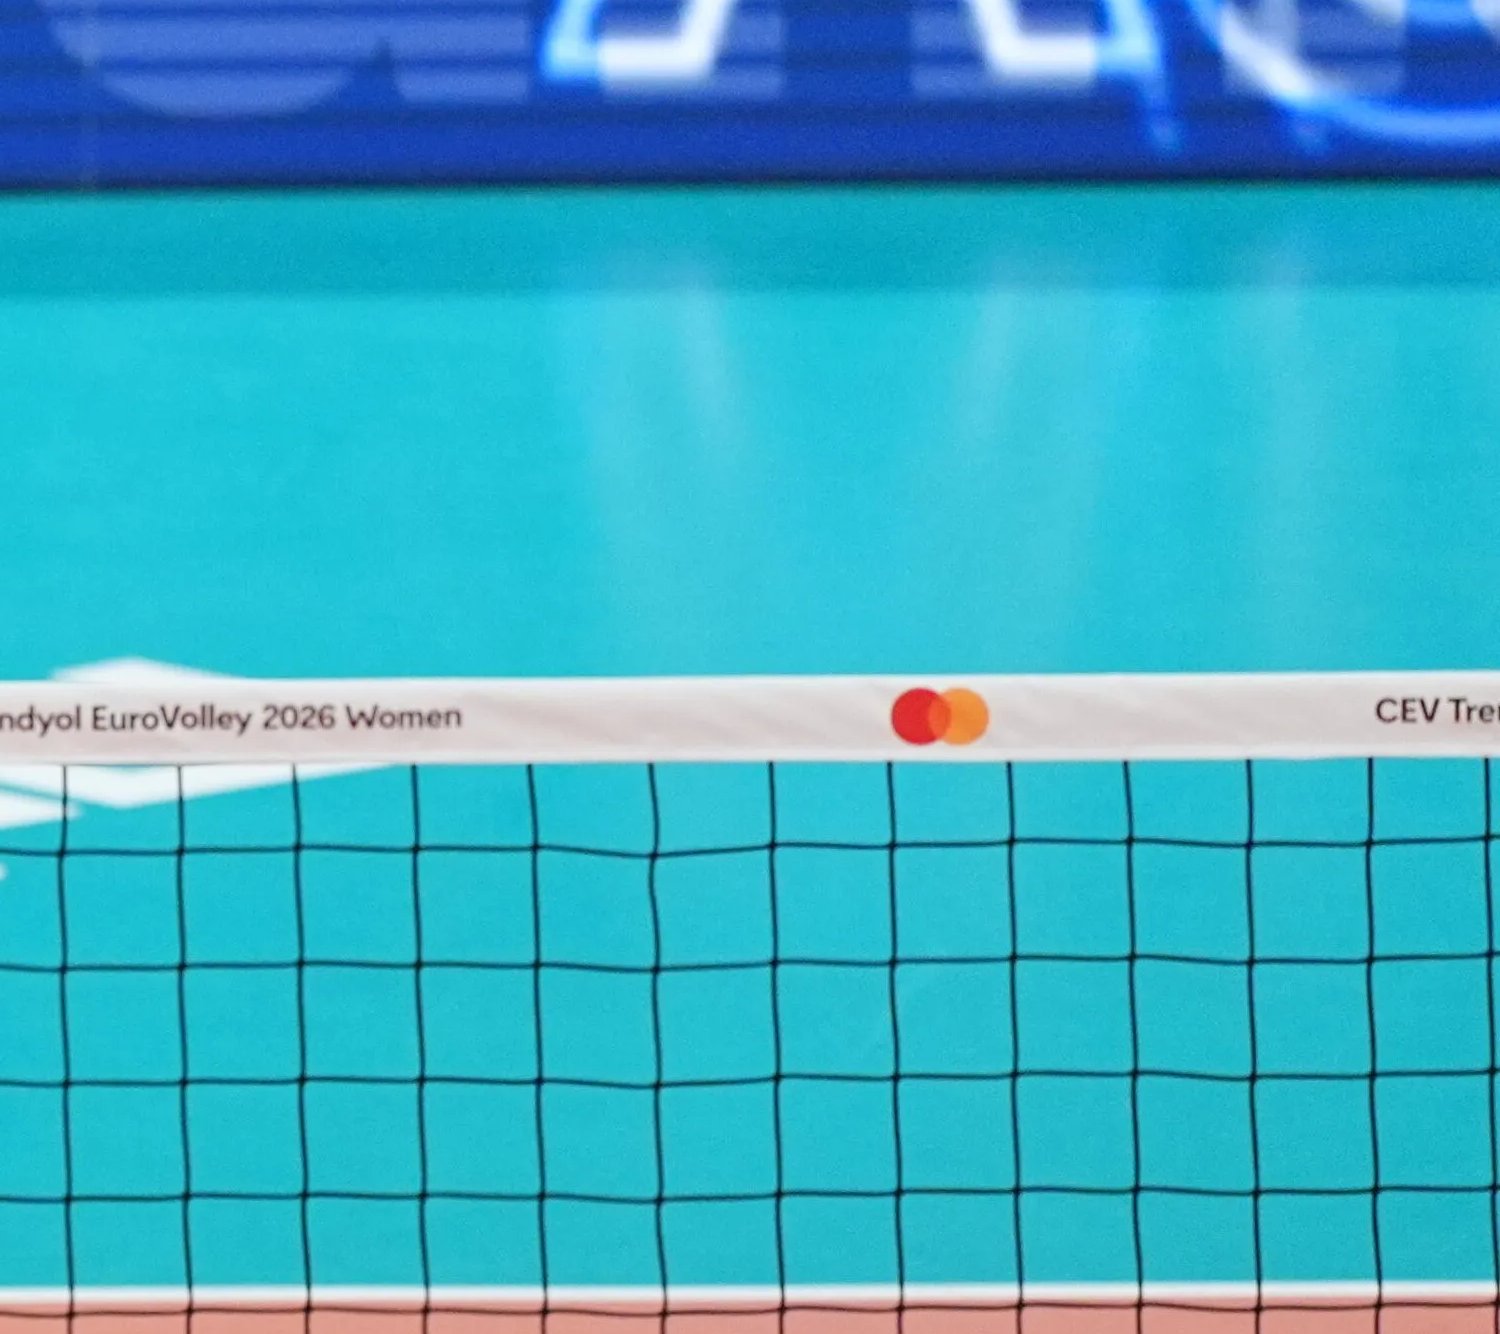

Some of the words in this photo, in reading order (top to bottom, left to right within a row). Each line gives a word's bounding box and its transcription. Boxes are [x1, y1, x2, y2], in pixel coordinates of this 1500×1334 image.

[92, 704, 252, 736] EuroVolley
[263, 705, 335, 730] 2026
[346, 705, 461, 730] Women
[1376, 698, 1440, 724] CEV
